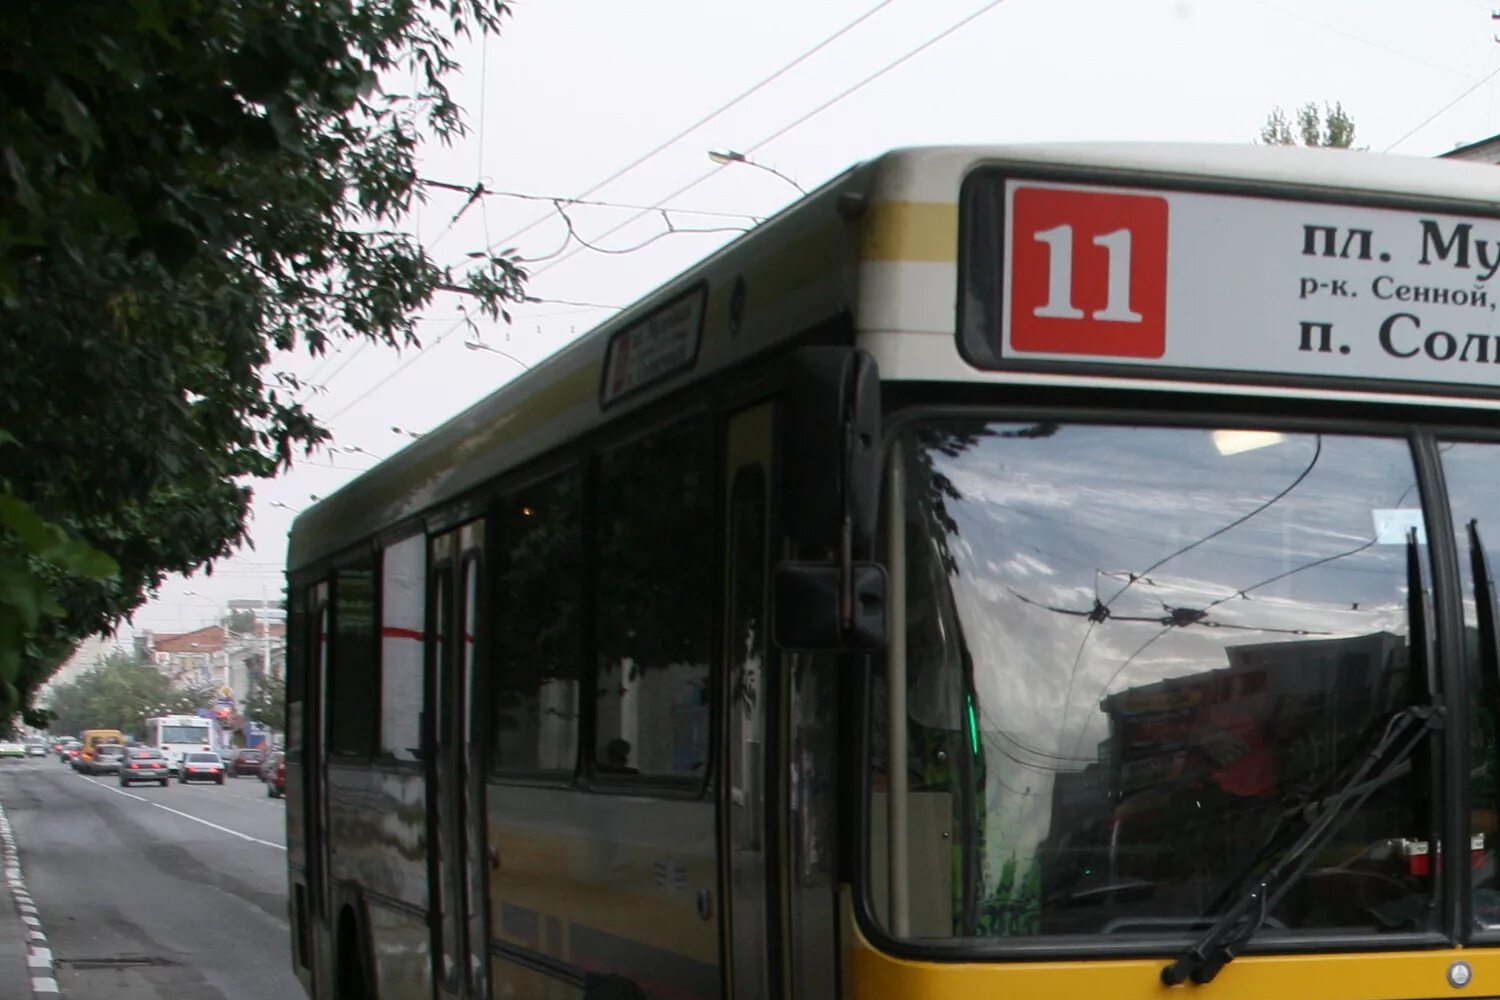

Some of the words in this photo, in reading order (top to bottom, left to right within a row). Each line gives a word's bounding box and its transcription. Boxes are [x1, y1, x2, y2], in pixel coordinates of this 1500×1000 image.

[1302, 224, 1392, 263] пл.
[1033, 223, 1143, 324] 11
[1299, 276, 1357, 299] р-к.
[1371, 275, 1497, 312] Сенной,
[1299, 321, 1351, 355] п.
